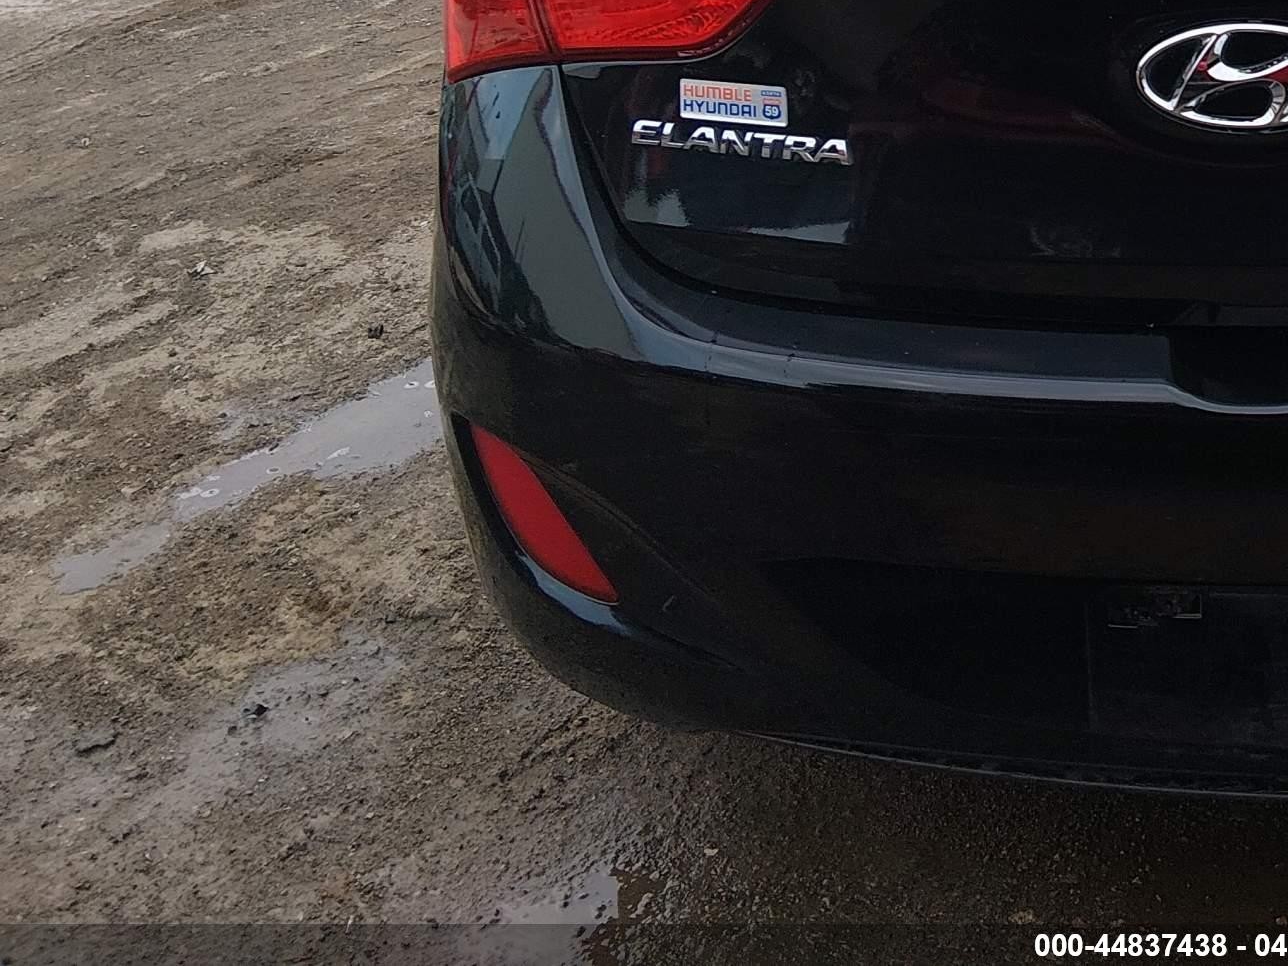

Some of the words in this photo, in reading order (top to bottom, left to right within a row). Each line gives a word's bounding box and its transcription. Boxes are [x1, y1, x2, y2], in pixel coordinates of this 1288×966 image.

[683, 84, 752, 102] HUMBLE
[683, 99, 757, 118] HYUNDAI
[765, 106, 780, 118] 59
[631, 119, 853, 165] ELANTRA
